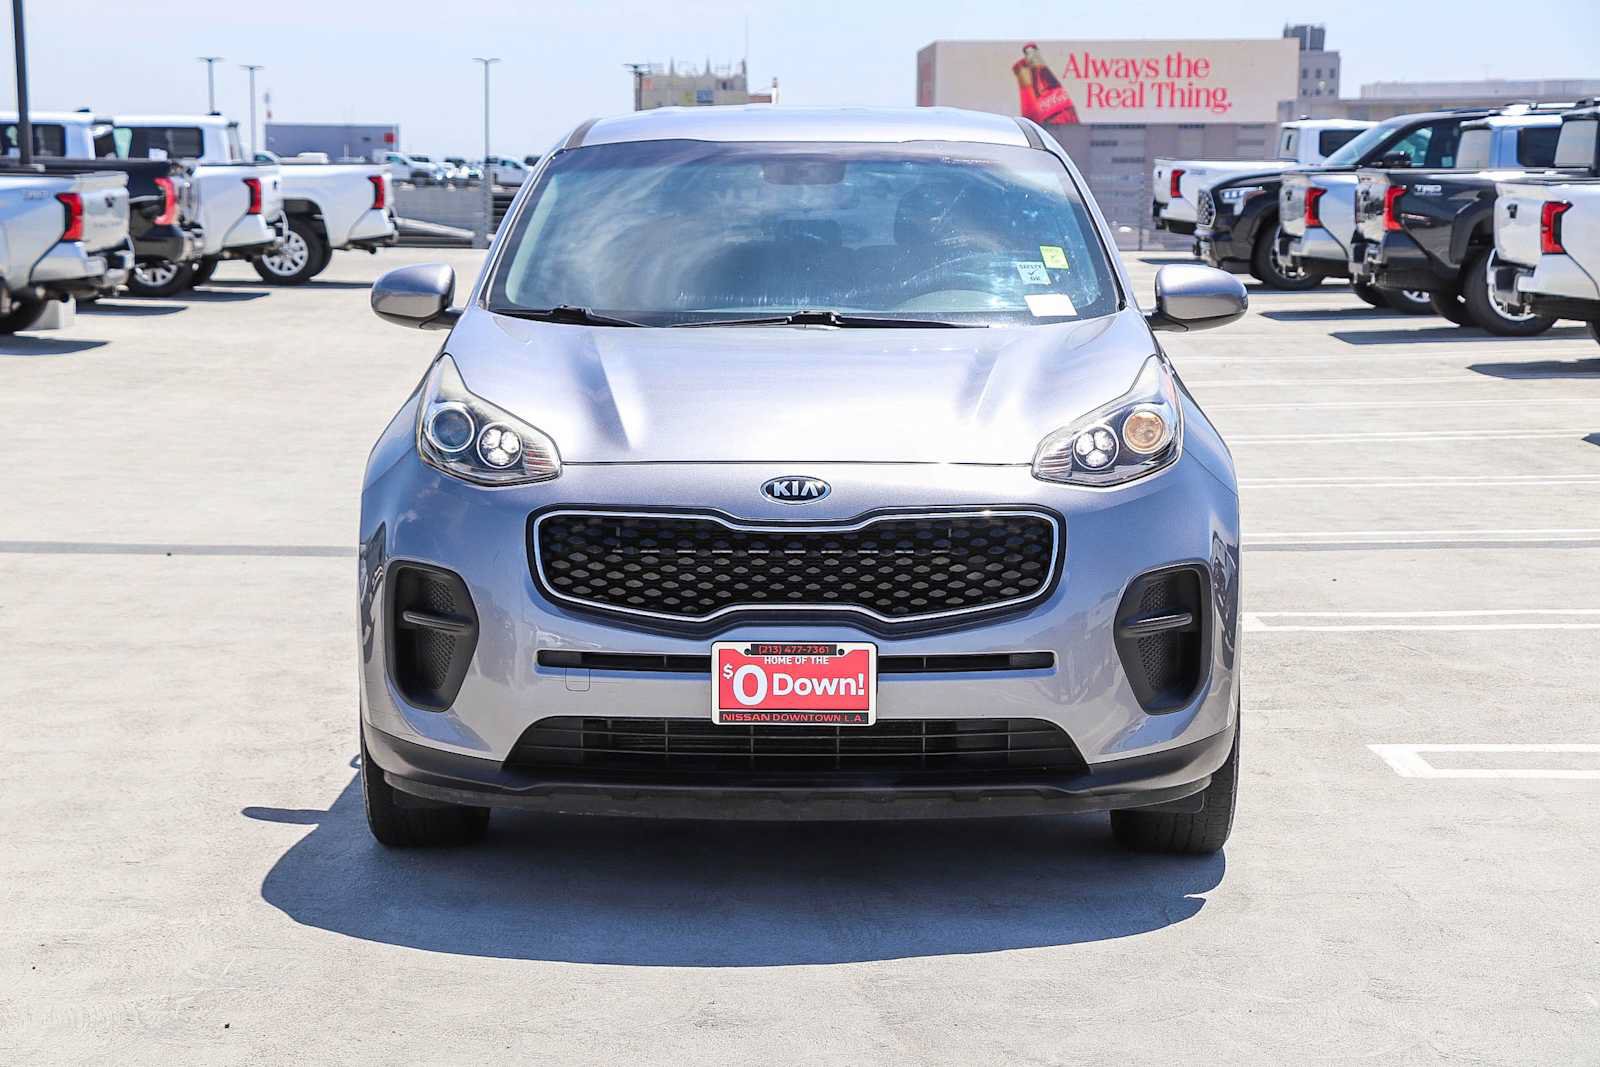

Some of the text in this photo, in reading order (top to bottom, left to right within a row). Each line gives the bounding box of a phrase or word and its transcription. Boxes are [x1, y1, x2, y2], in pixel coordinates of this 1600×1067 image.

[1063, 52, 1210, 84] Always the
[1086, 82, 1144, 108] Real
[1151, 82, 1233, 113] Thing.
[773, 480, 819, 497] KIA
[758, 645, 830, 655] (213) 477-7361
[764, 656, 829, 665] HOME OF THE
[772, 673, 865, 696] Down!
[722, 713, 770, 721] NISSAN
[772, 713, 841, 722] DOWNTOWN
